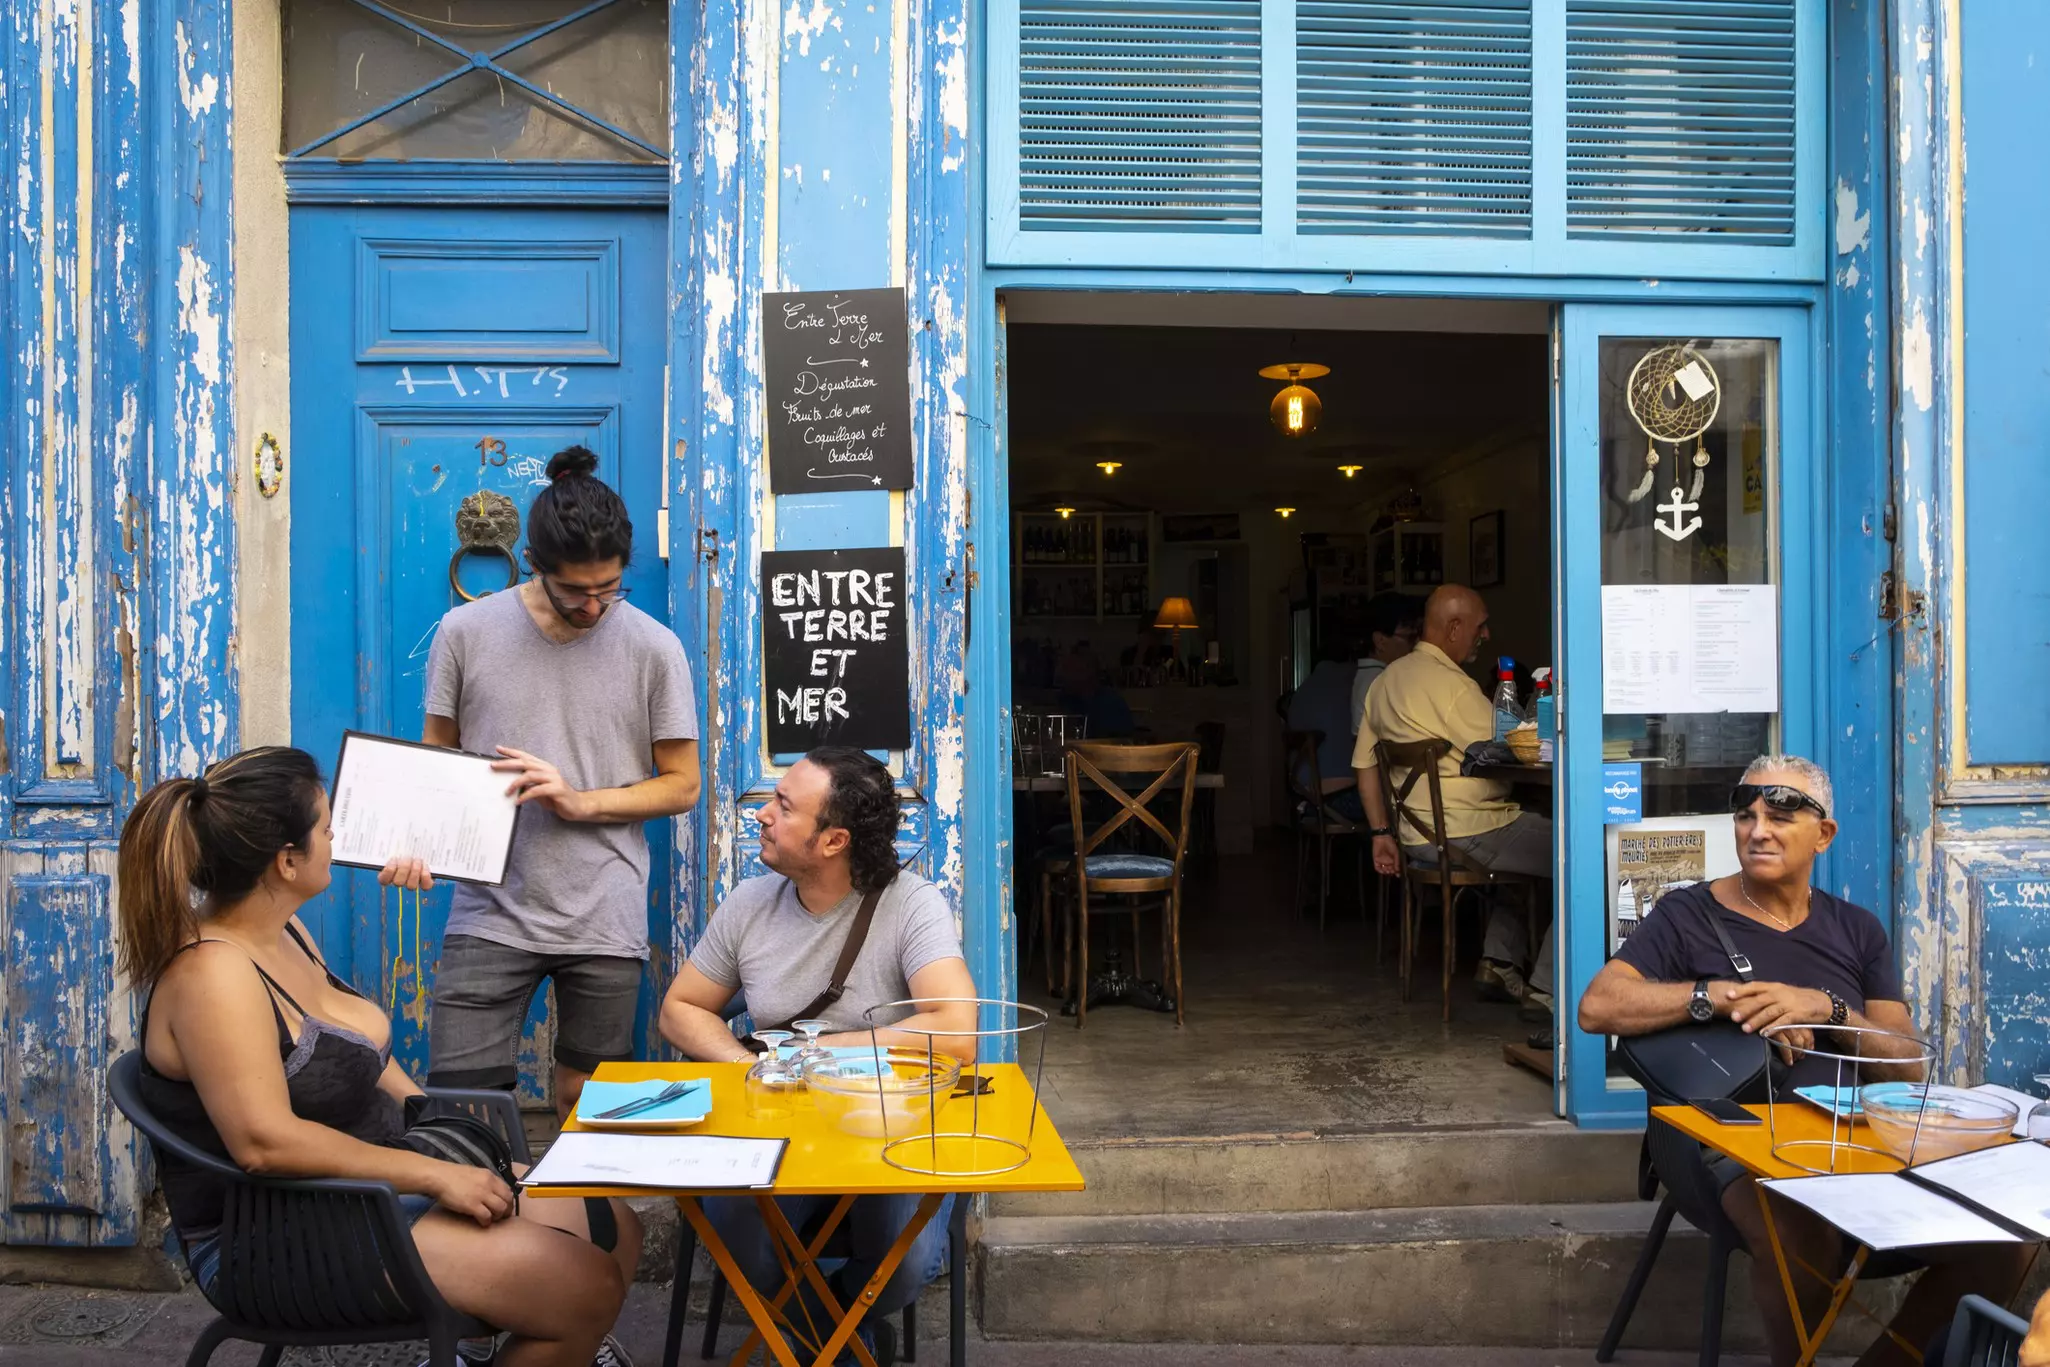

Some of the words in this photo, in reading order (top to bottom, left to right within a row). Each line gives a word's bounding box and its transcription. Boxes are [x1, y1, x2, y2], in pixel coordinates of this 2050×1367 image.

[783, 302, 825, 330] Entre
[826, 299, 869, 328] Terre
[850, 324, 884, 349] Mer
[794, 371, 878, 401] Dégustation
[782, 400, 822, 425] Fruits
[825, 403, 843, 420] de
[845, 404, 873, 418] mer
[475, 436, 508, 467] 13
[803, 426, 866, 451] Coquillages
[871, 422, 888, 438] et
[772, 569, 895, 608] ENTRE
[779, 609, 890, 642] TERRE
[810, 649, 857, 678] ET
[777, 686, 849, 725] MER
[1649, 836, 1660, 849] DES
